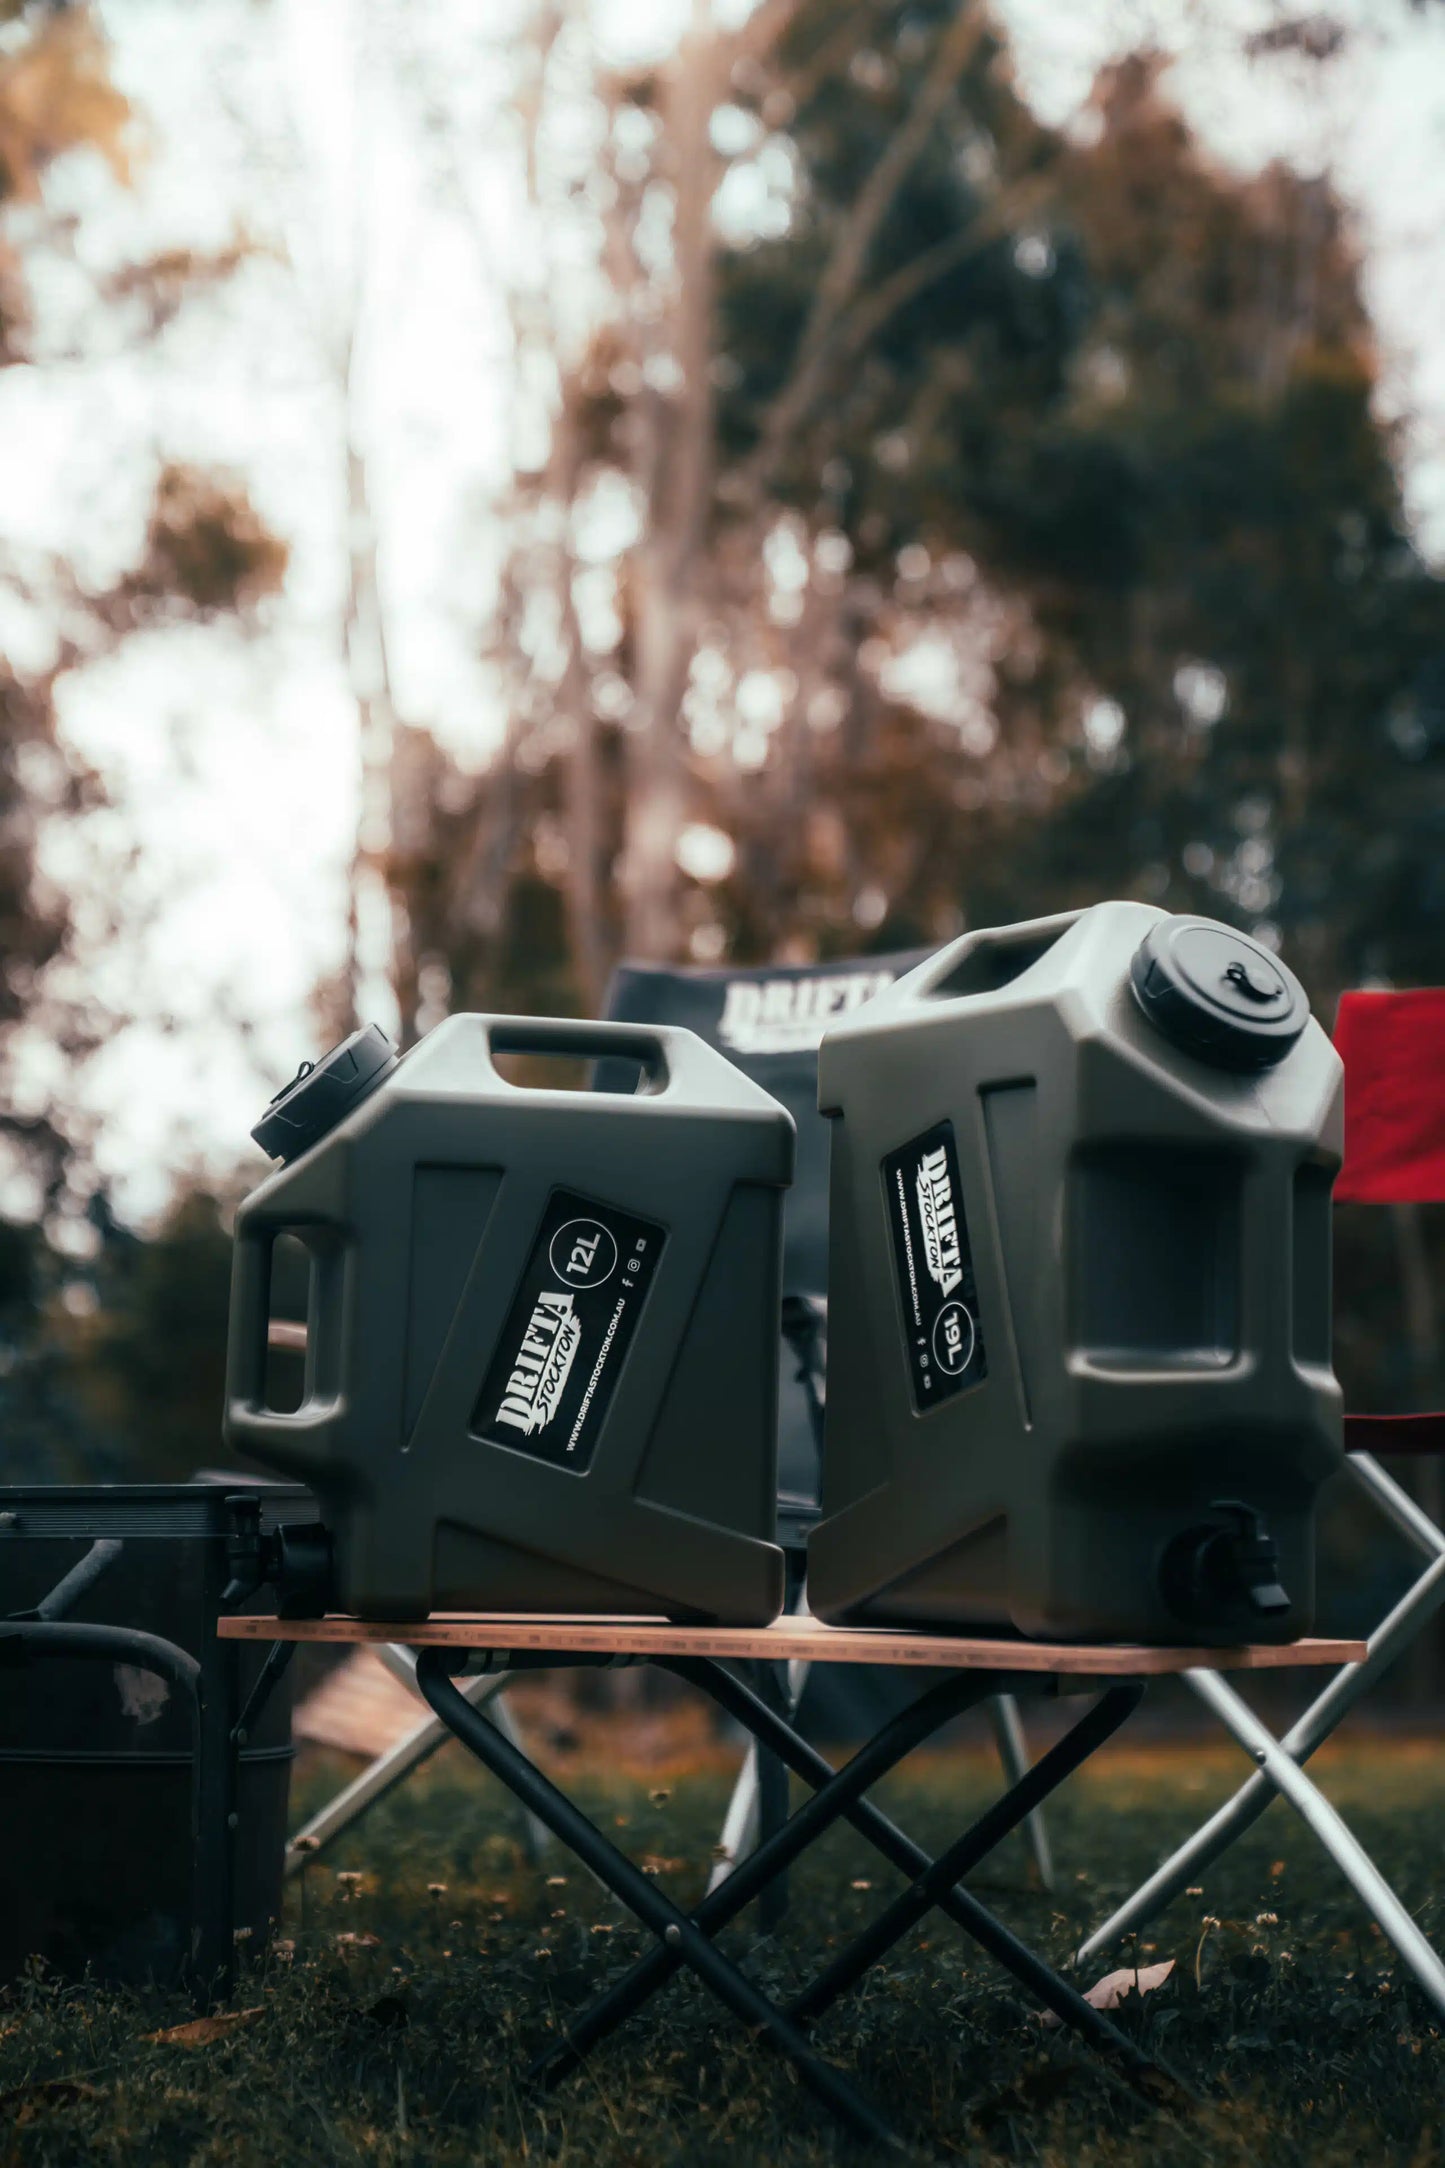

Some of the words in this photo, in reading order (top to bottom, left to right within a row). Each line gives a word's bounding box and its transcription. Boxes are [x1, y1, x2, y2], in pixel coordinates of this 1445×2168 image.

[566, 1233, 601, 1275] 12L
[918, 1178, 941, 1270] STOCKTON
[922, 1145, 963, 1298] DRIFTA
[495, 1290, 575, 1433] DRIFTA
[535, 1322, 578, 1421] STOCKTON
[566, 1298, 627, 1452] WWW.DRIFTASTOCKTON.COM.AU
[943, 1311, 963, 1366] 19L
